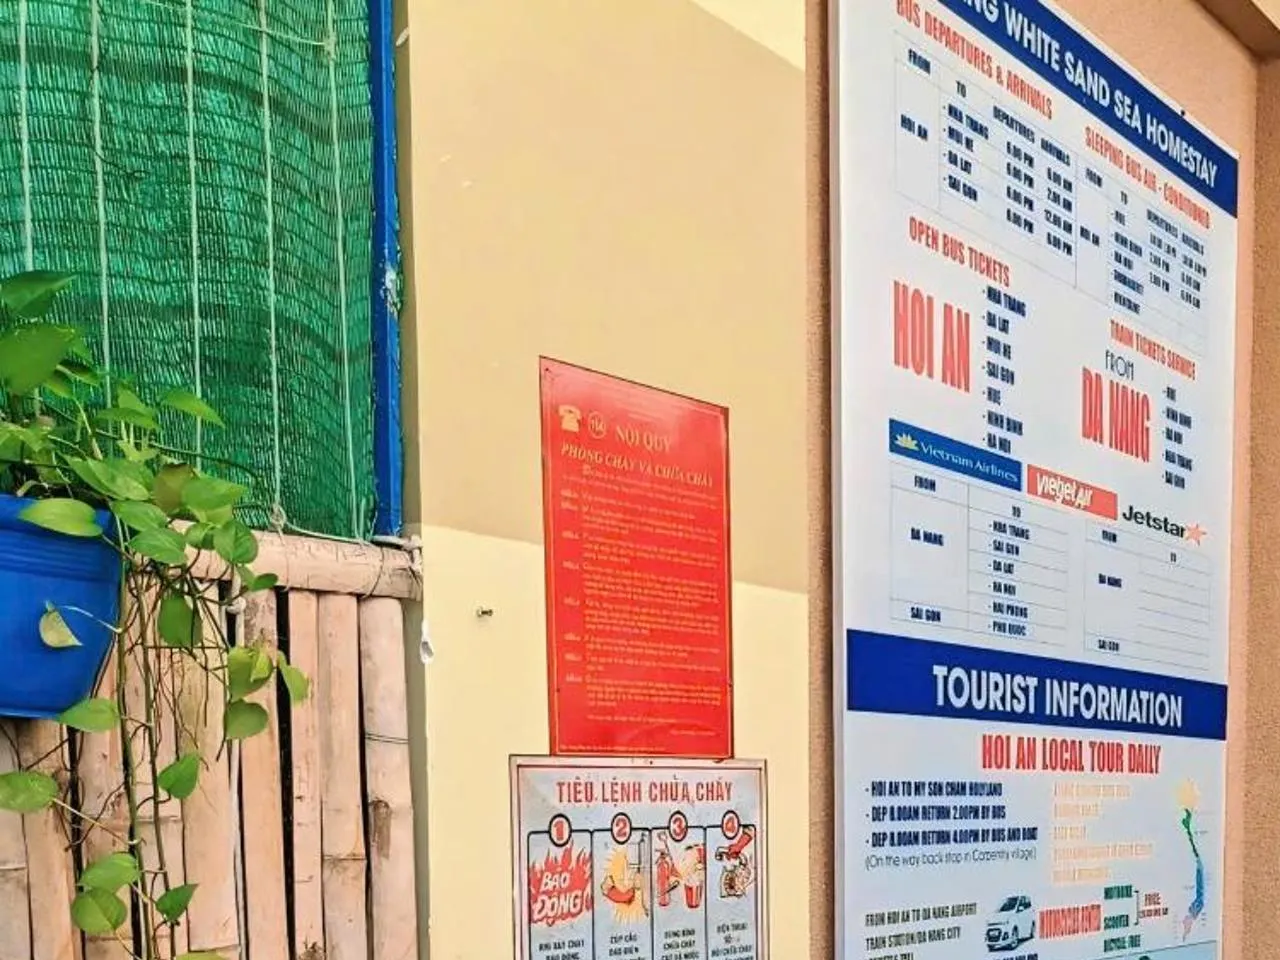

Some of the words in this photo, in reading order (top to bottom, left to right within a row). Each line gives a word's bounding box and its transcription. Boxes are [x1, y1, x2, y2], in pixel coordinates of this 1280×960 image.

[924, 11, 993, 78] DEPARTURES
[1006, 70, 1052, 120] ARRIVALS
[1004, 2, 1060, 72] WHITE
[1064, 51, 1110, 107] SAND
[1113, 89, 1143, 134] SEA
[1146, 113, 1218, 188] HOMESTAY
[909, 215, 939, 255] OPEN
[942, 233, 965, 266] BUS
[968, 246, 1010, 288] TICKETS
[893, 279, 934, 380] HOI
[941, 302, 970, 394] AN
[1081, 366, 1104, 445] DA
[1109, 379, 1151, 463] NANG
[920, 441, 974, 469] Vietnam
[1122, 504, 1187, 539] Jetstar
[933, 664, 1039, 714] TOURIST
[1045, 678, 1184, 729] INFORMATION
[982, 734, 1011, 770] HOI
[1015, 736, 1037, 770] AN
[1042, 738, 1084, 772] LOCAL
[1089, 741, 1124, 774] TOUR
[1128, 743, 1161, 775] DAILY
[554, 820, 565, 840] 1
[615, 817, 627, 838] 2
[672, 816, 685, 836] 3
[725, 815, 736, 834] 4
